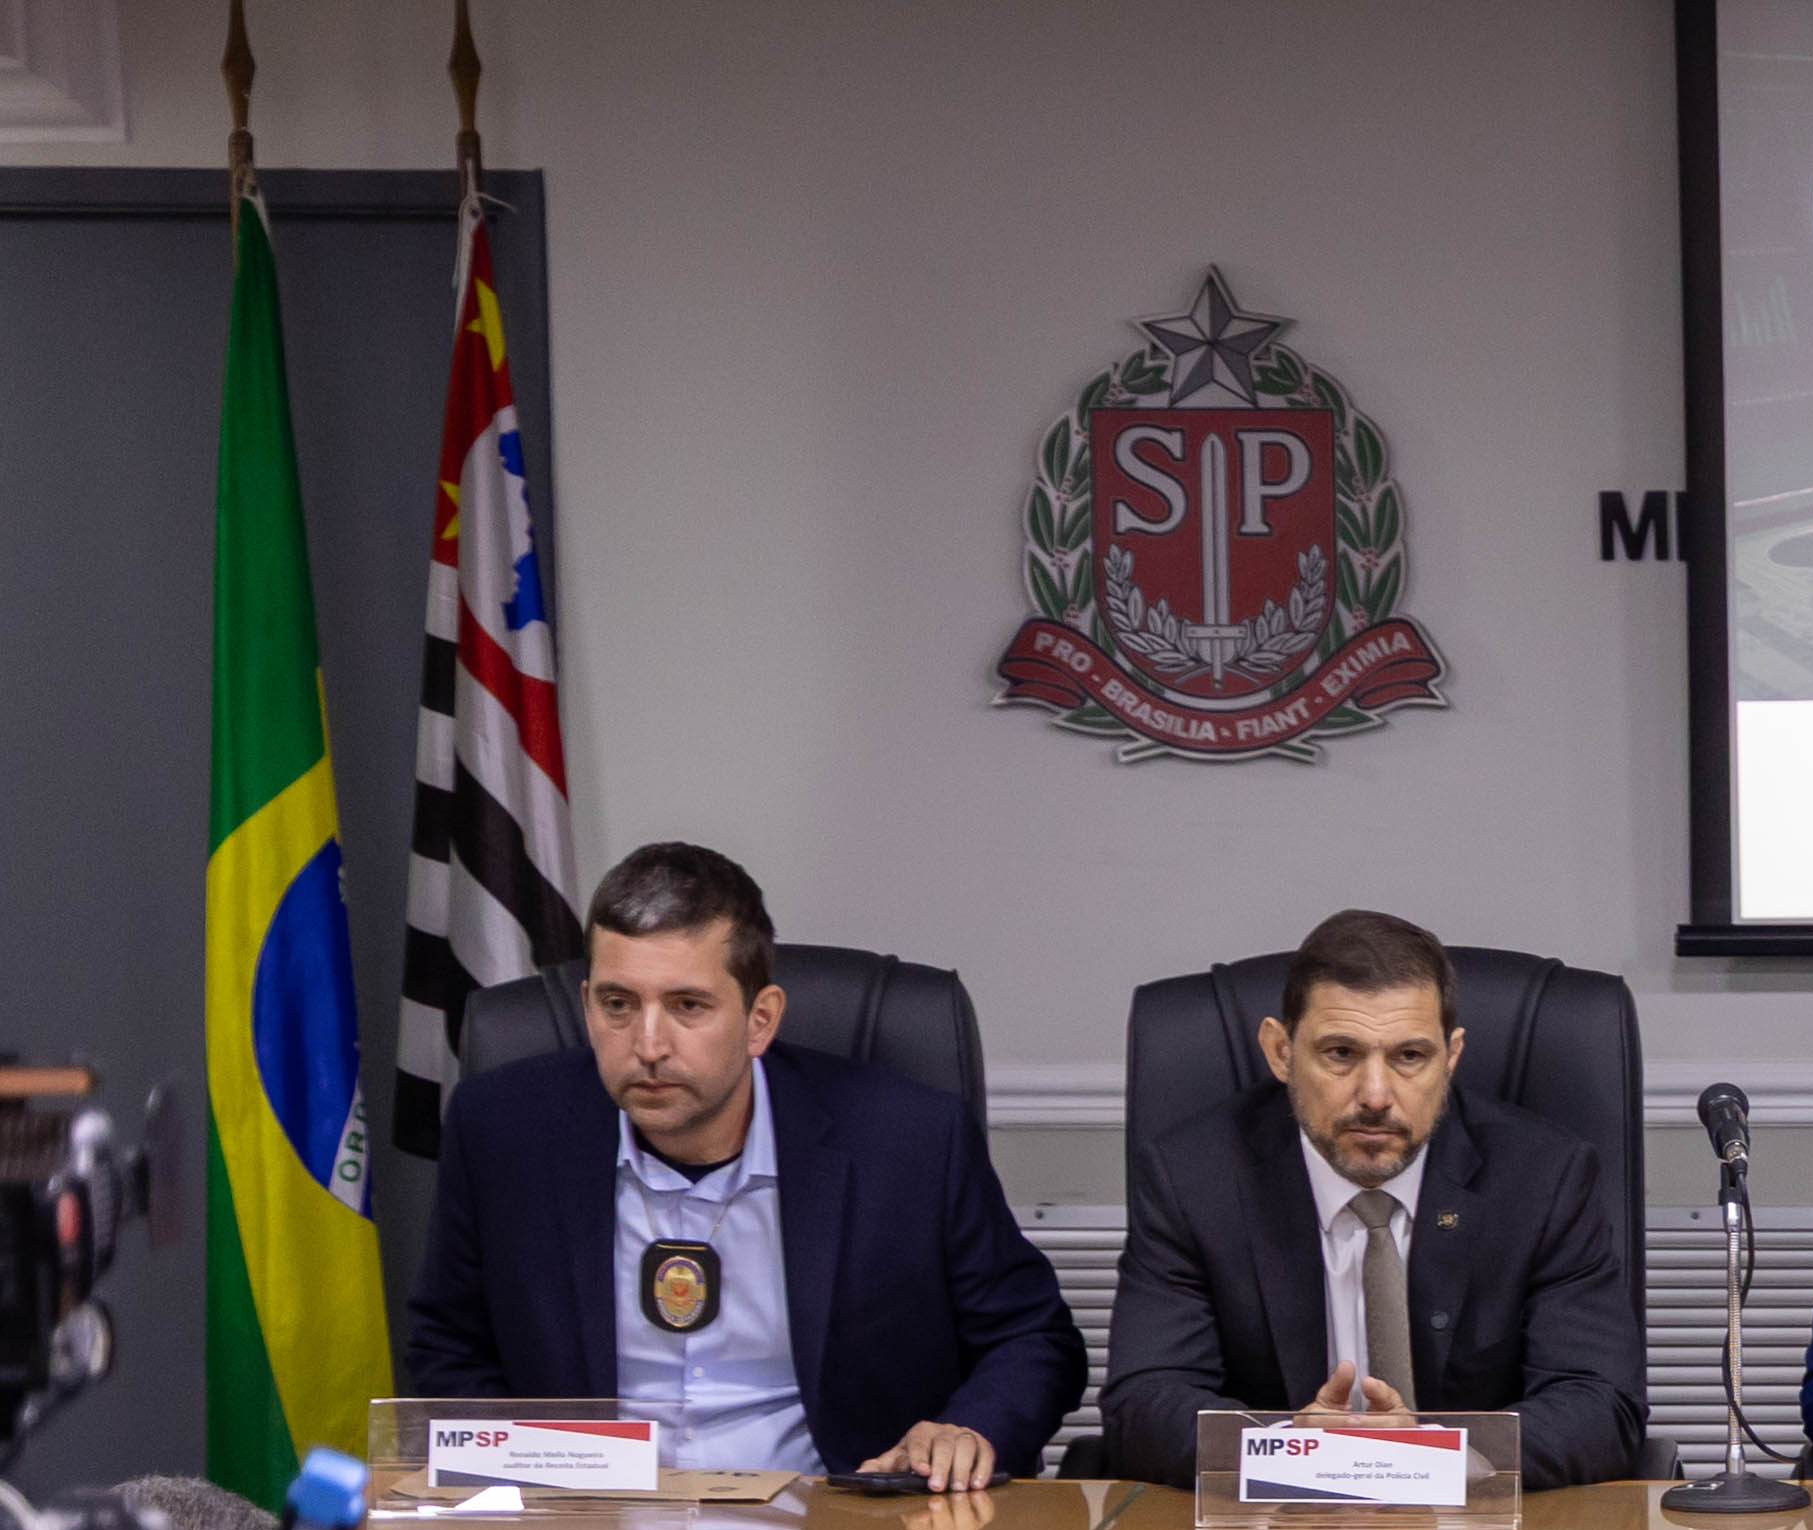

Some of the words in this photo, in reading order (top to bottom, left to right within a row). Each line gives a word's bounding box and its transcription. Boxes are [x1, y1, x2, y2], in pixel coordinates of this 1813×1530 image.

[1034, 631, 1094, 673] PRO
[1101, 678, 1217, 742] BRASILIA
[1235, 697, 1310, 741] FIANT
[1320, 631, 1412, 696] EXIMIA
[435, 1431, 509, 1447] MPSP
[1247, 1438, 1319, 1455] MPSP
